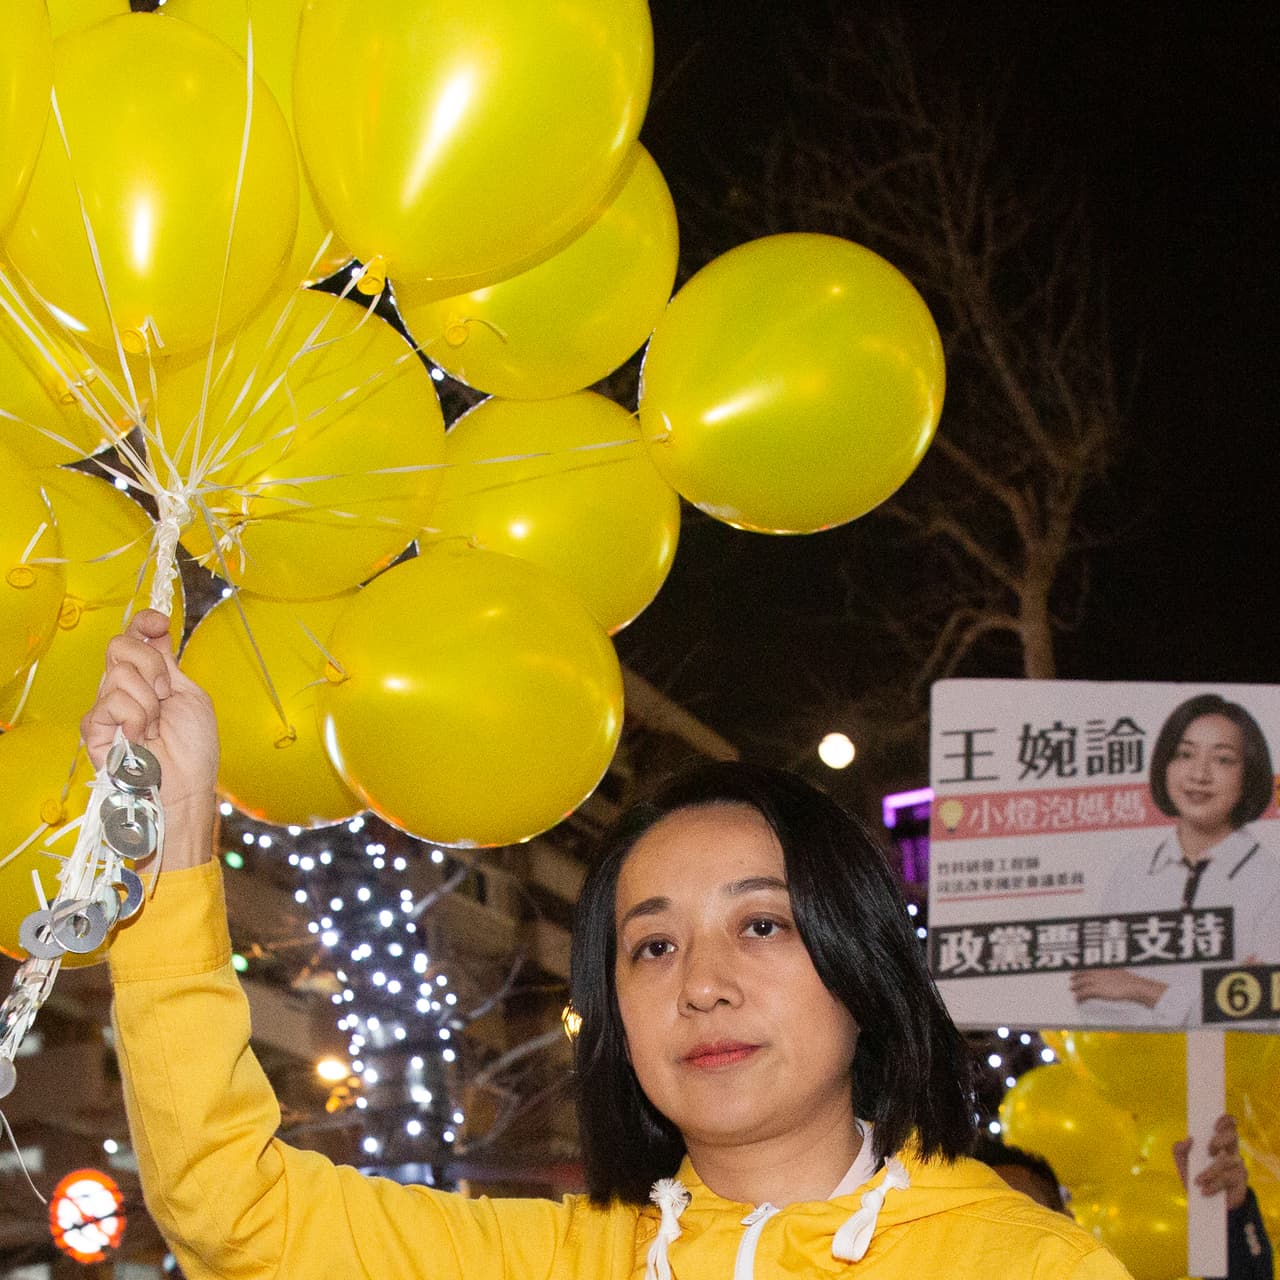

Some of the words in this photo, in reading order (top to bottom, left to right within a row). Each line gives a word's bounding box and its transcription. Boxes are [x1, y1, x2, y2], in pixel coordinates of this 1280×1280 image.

[937, 716, 1147, 785] 王婉諭
[937, 912, 1226, 974] 政黨票請支持
